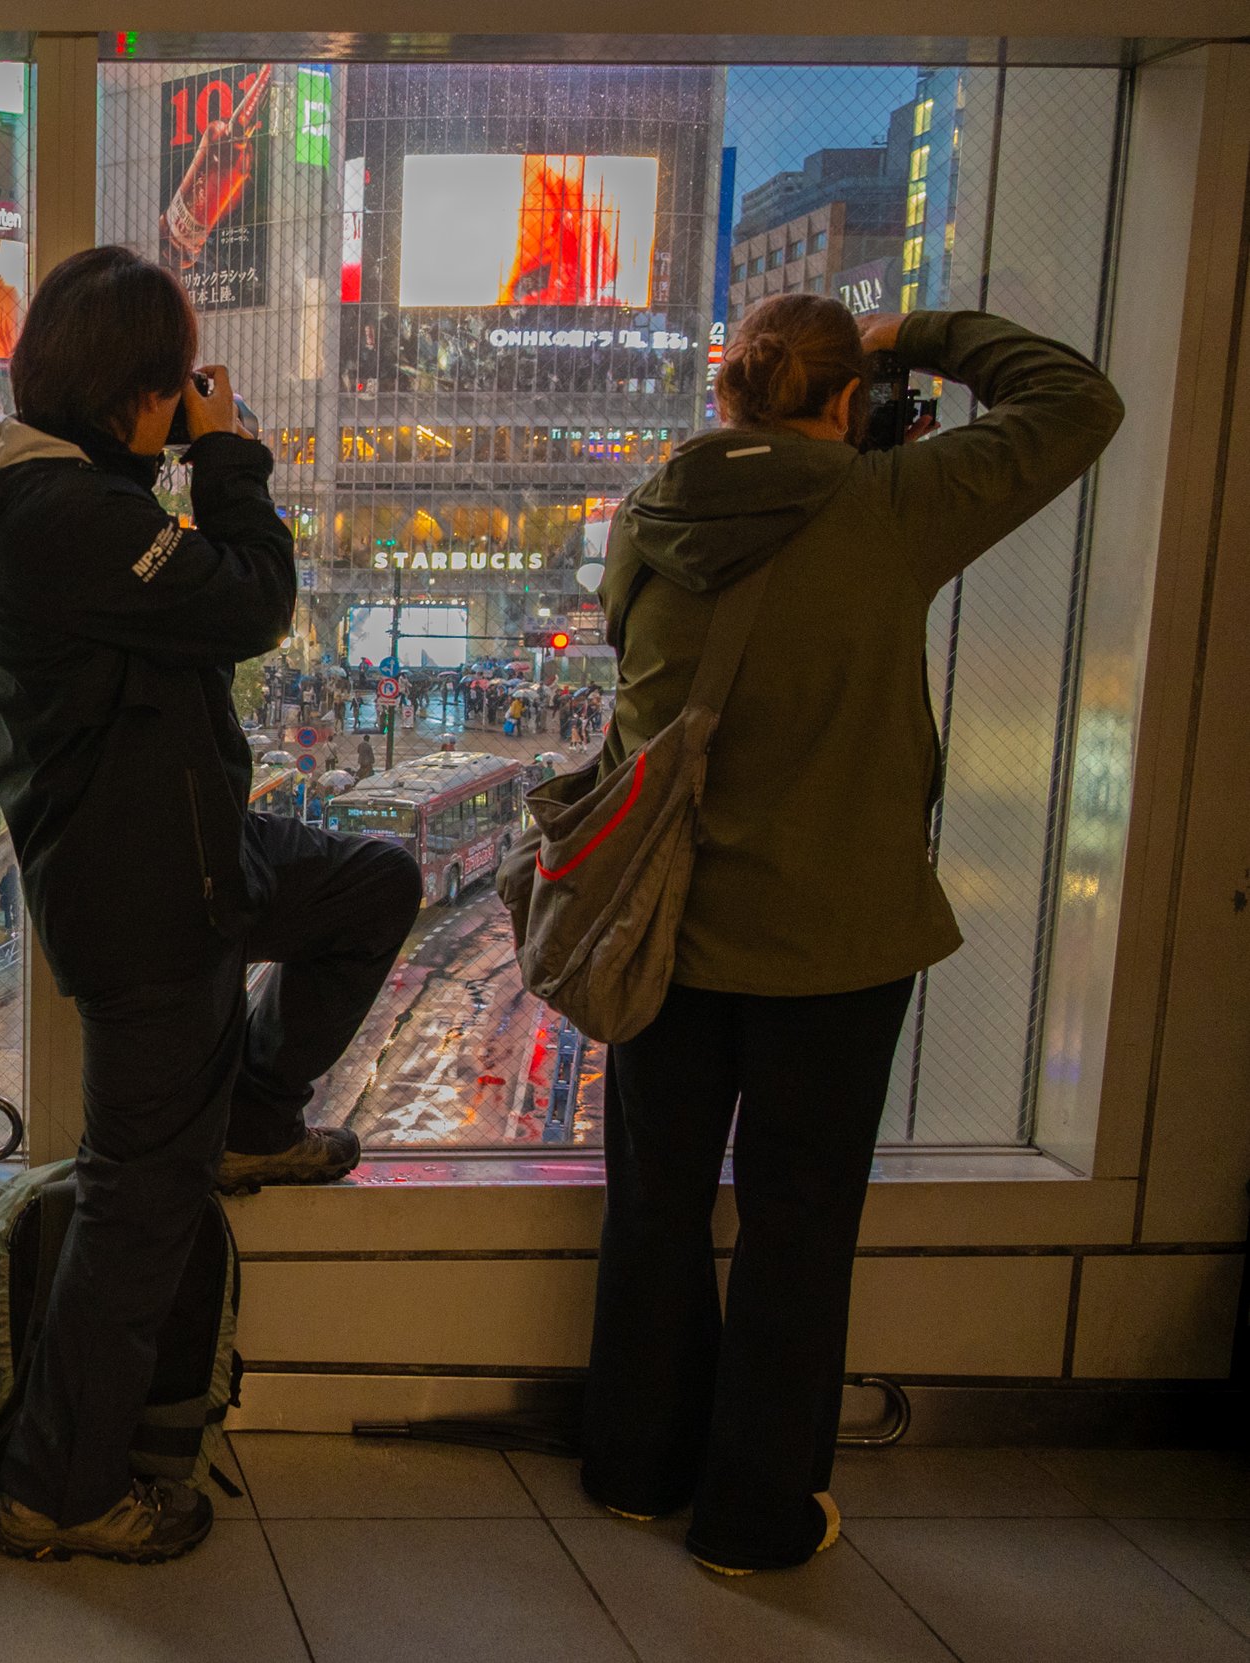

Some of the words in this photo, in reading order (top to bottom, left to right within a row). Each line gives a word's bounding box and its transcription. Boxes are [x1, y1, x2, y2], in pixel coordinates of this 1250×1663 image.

[188, 286, 235, 304] 日本上陸。
[131, 542, 164, 577] NPS
[374, 552, 543, 570] STARBUCKS
